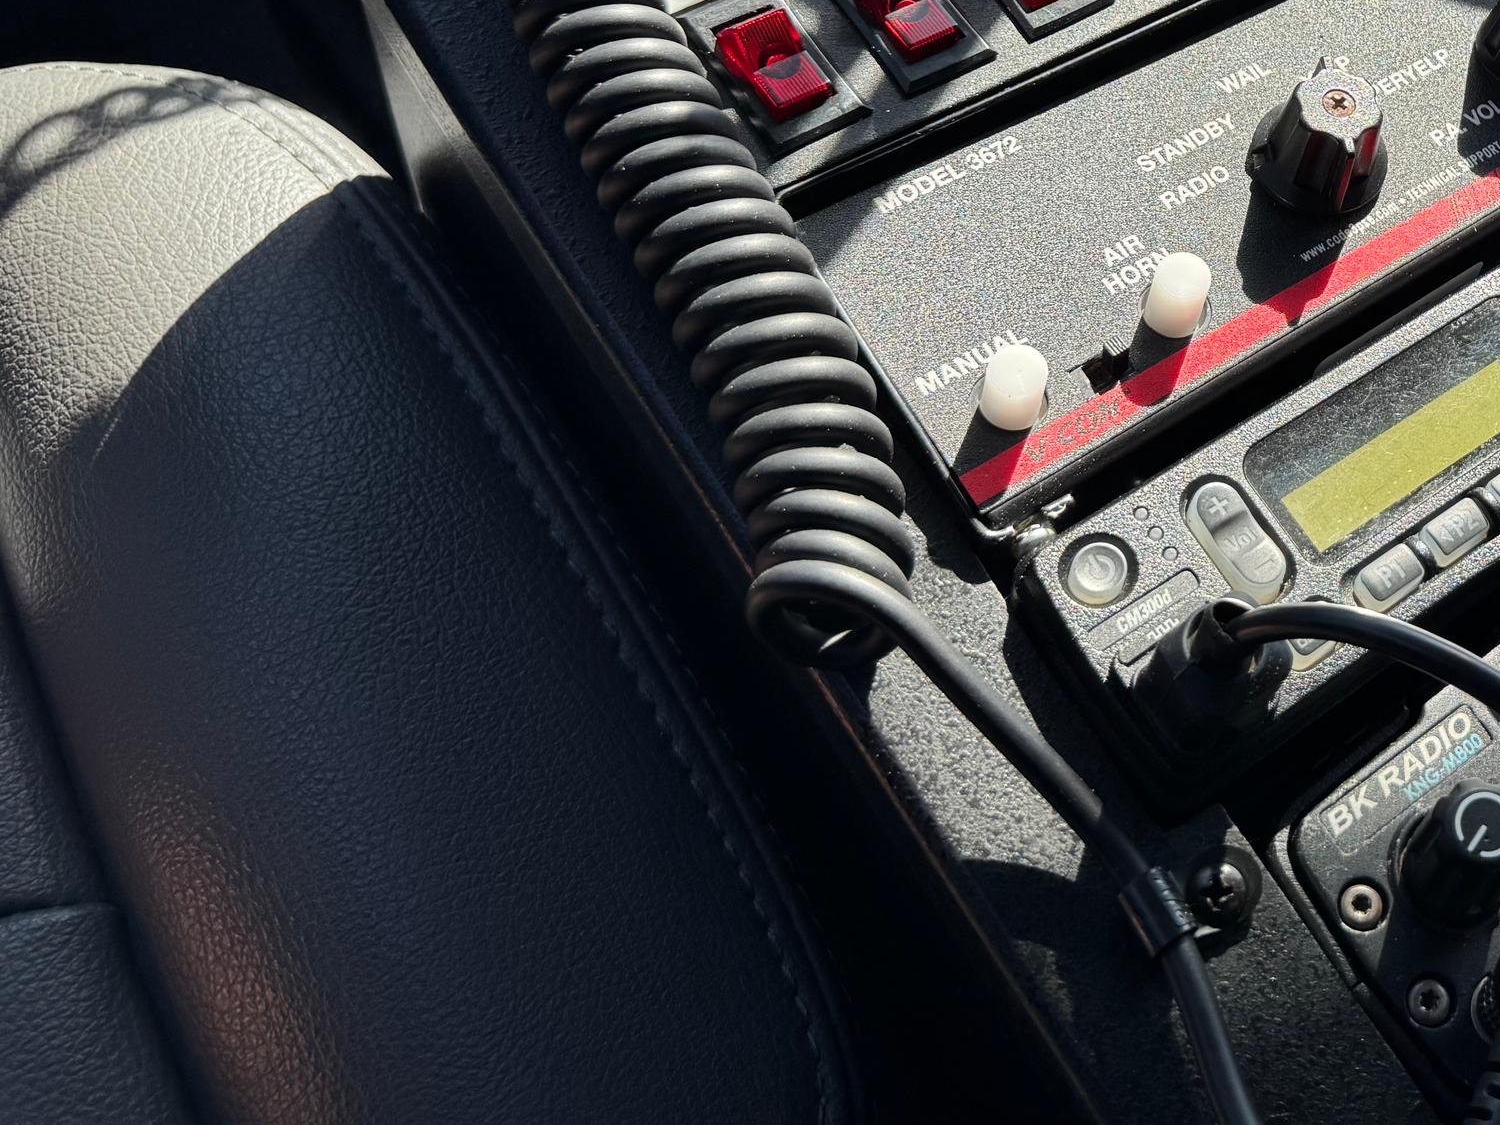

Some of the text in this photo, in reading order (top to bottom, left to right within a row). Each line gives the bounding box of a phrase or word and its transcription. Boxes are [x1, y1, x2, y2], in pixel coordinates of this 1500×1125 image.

[1216, 62, 1271, 94] WAIL
[1137, 113, 1235, 173] STANDBY
[1431, 120, 1468, 149] P.A.
[876, 135, 1023, 215] MODEL 3672
[1159, 164, 1232, 210] RADIO
[1405, 163, 1461, 202] TECHNICAL
[1104, 234, 1146, 268] AIR
[914, 329, 1030, 396] MANUAL
[1224, 530, 1260, 553] Vol
[1450, 510, 1480, 538] P2
[1376, 559, 1407, 589] P1
[1115, 586, 1173, 634] CM300d
[1326, 712, 1472, 836] BK RADIO
[1402, 733, 1484, 802] KNG-M800
